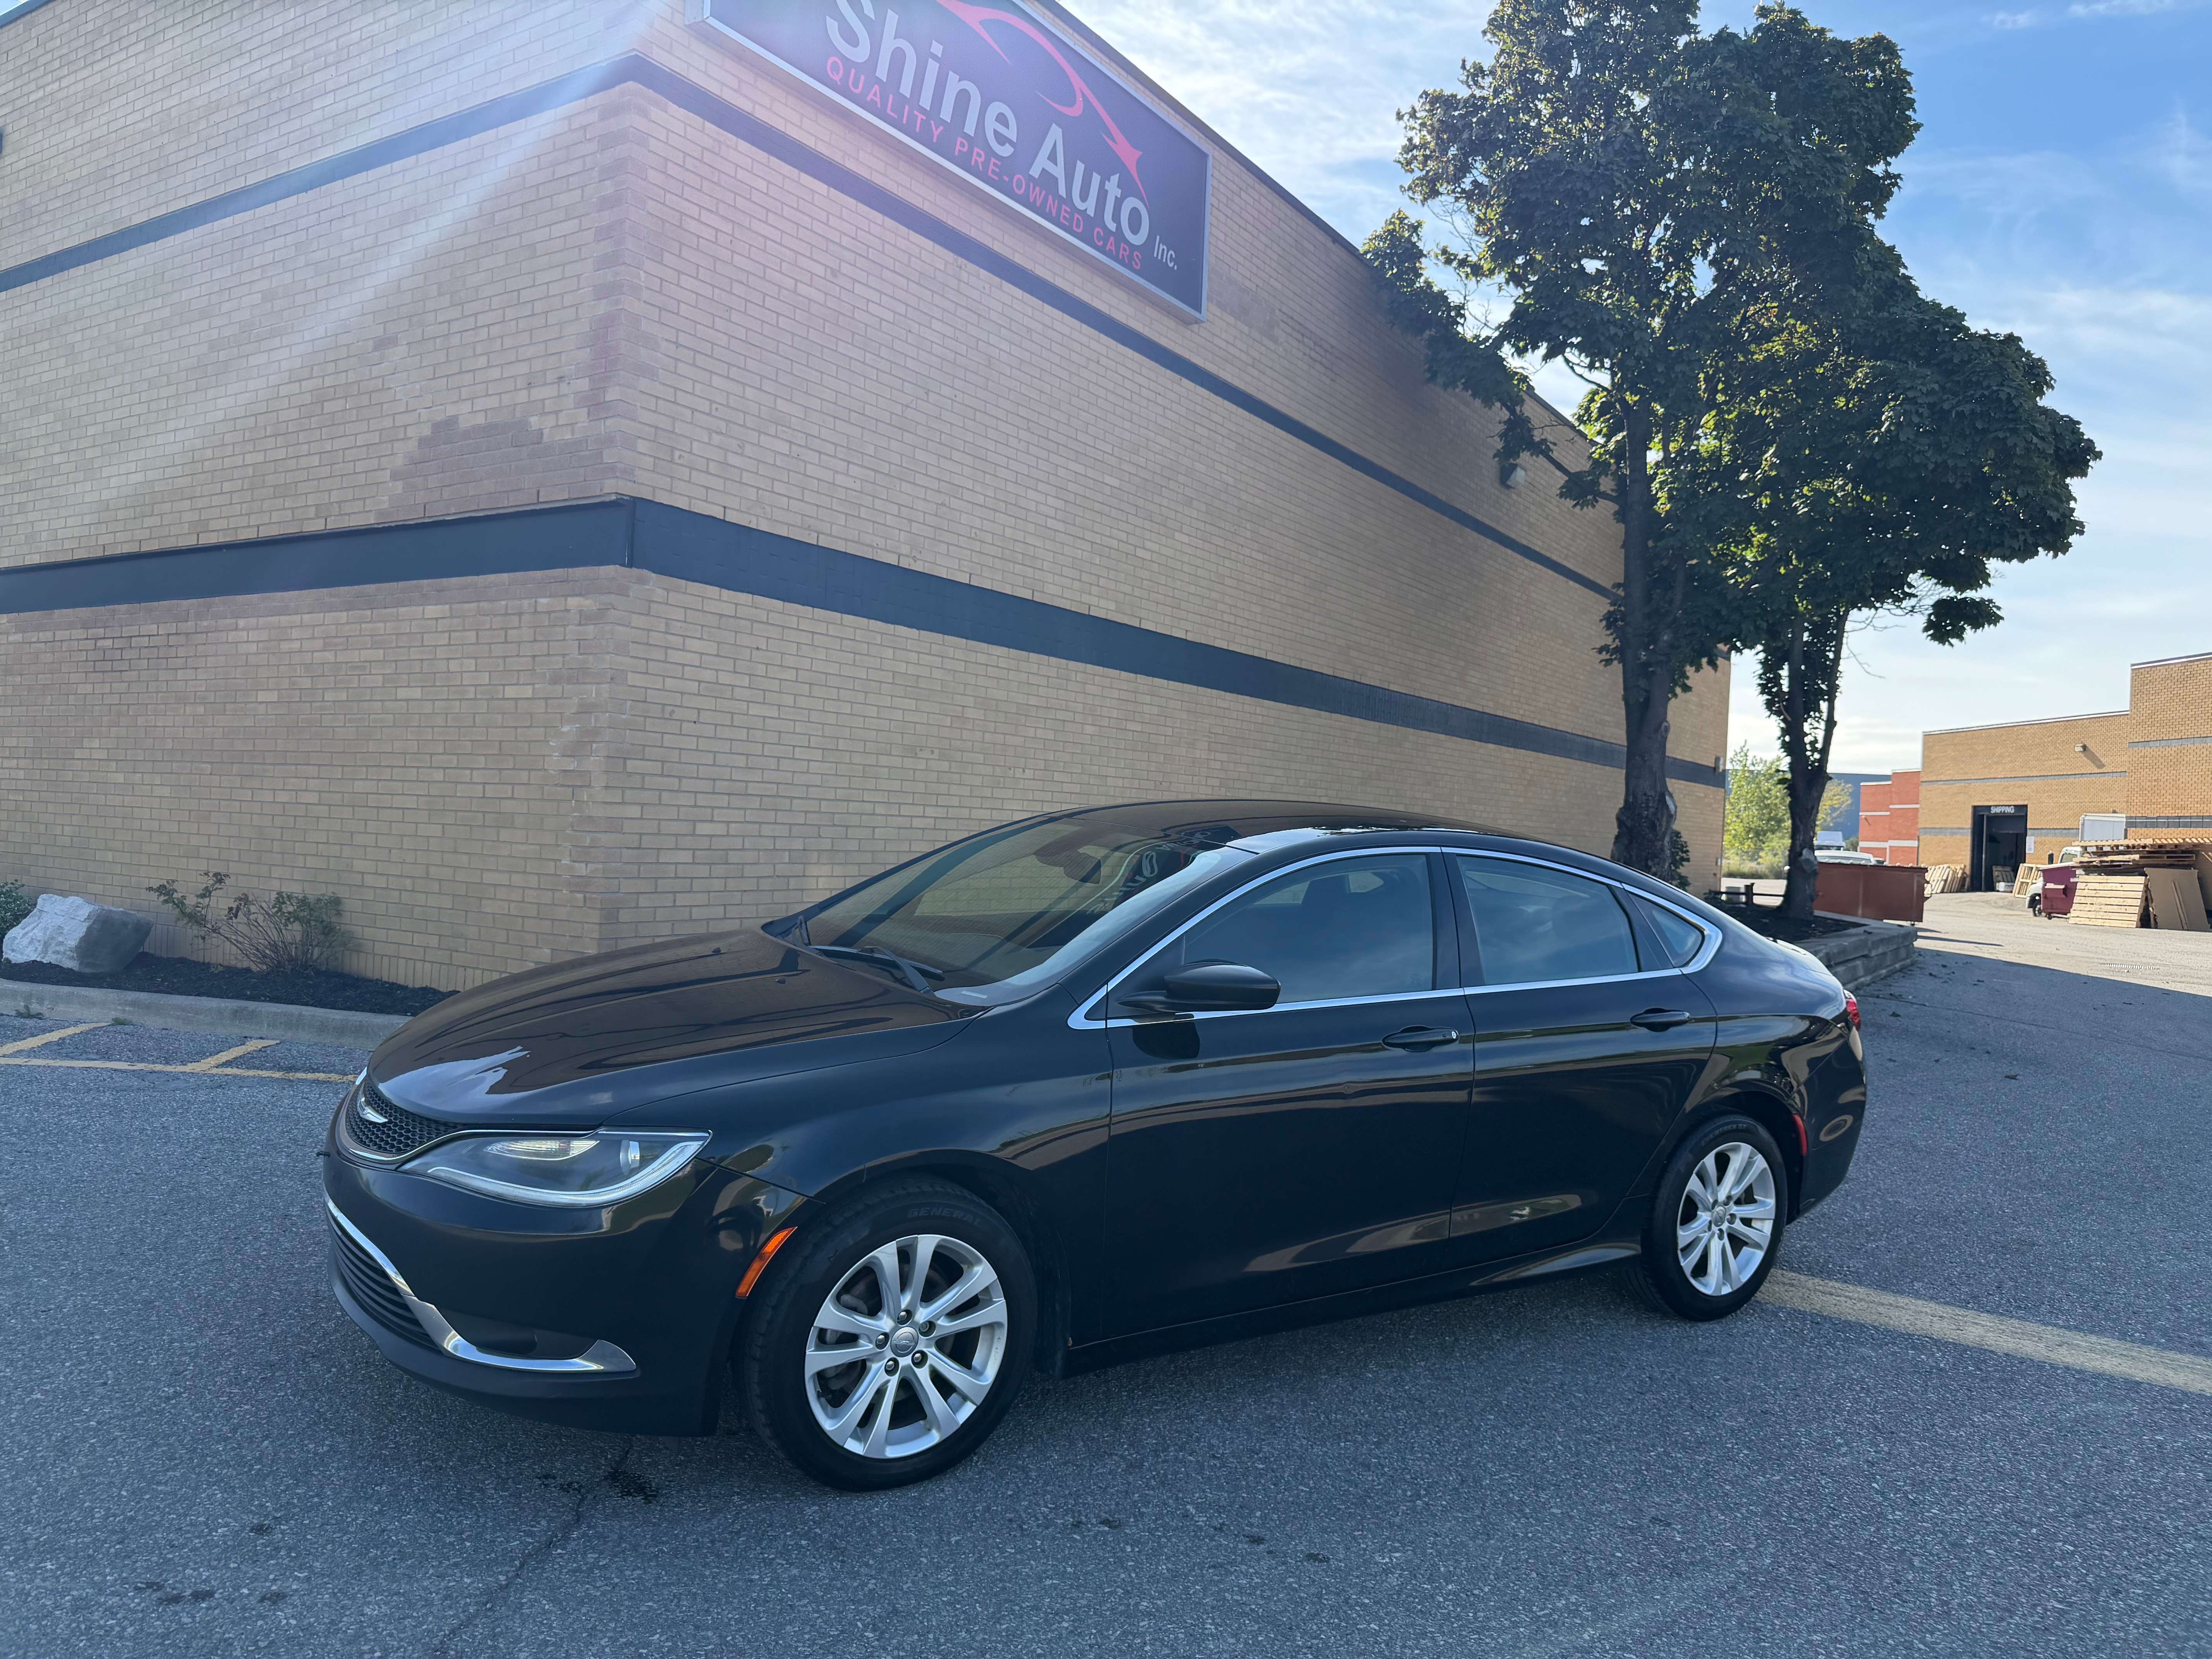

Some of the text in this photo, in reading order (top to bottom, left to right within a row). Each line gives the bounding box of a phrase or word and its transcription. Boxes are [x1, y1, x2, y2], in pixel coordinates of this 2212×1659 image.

[826, 0, 1177, 270] Shine Auto Inc.
[826, 56, 1142, 270] QUALITY PRE-OWNED CARS
[908, 1207, 982, 1227] GENERAL
